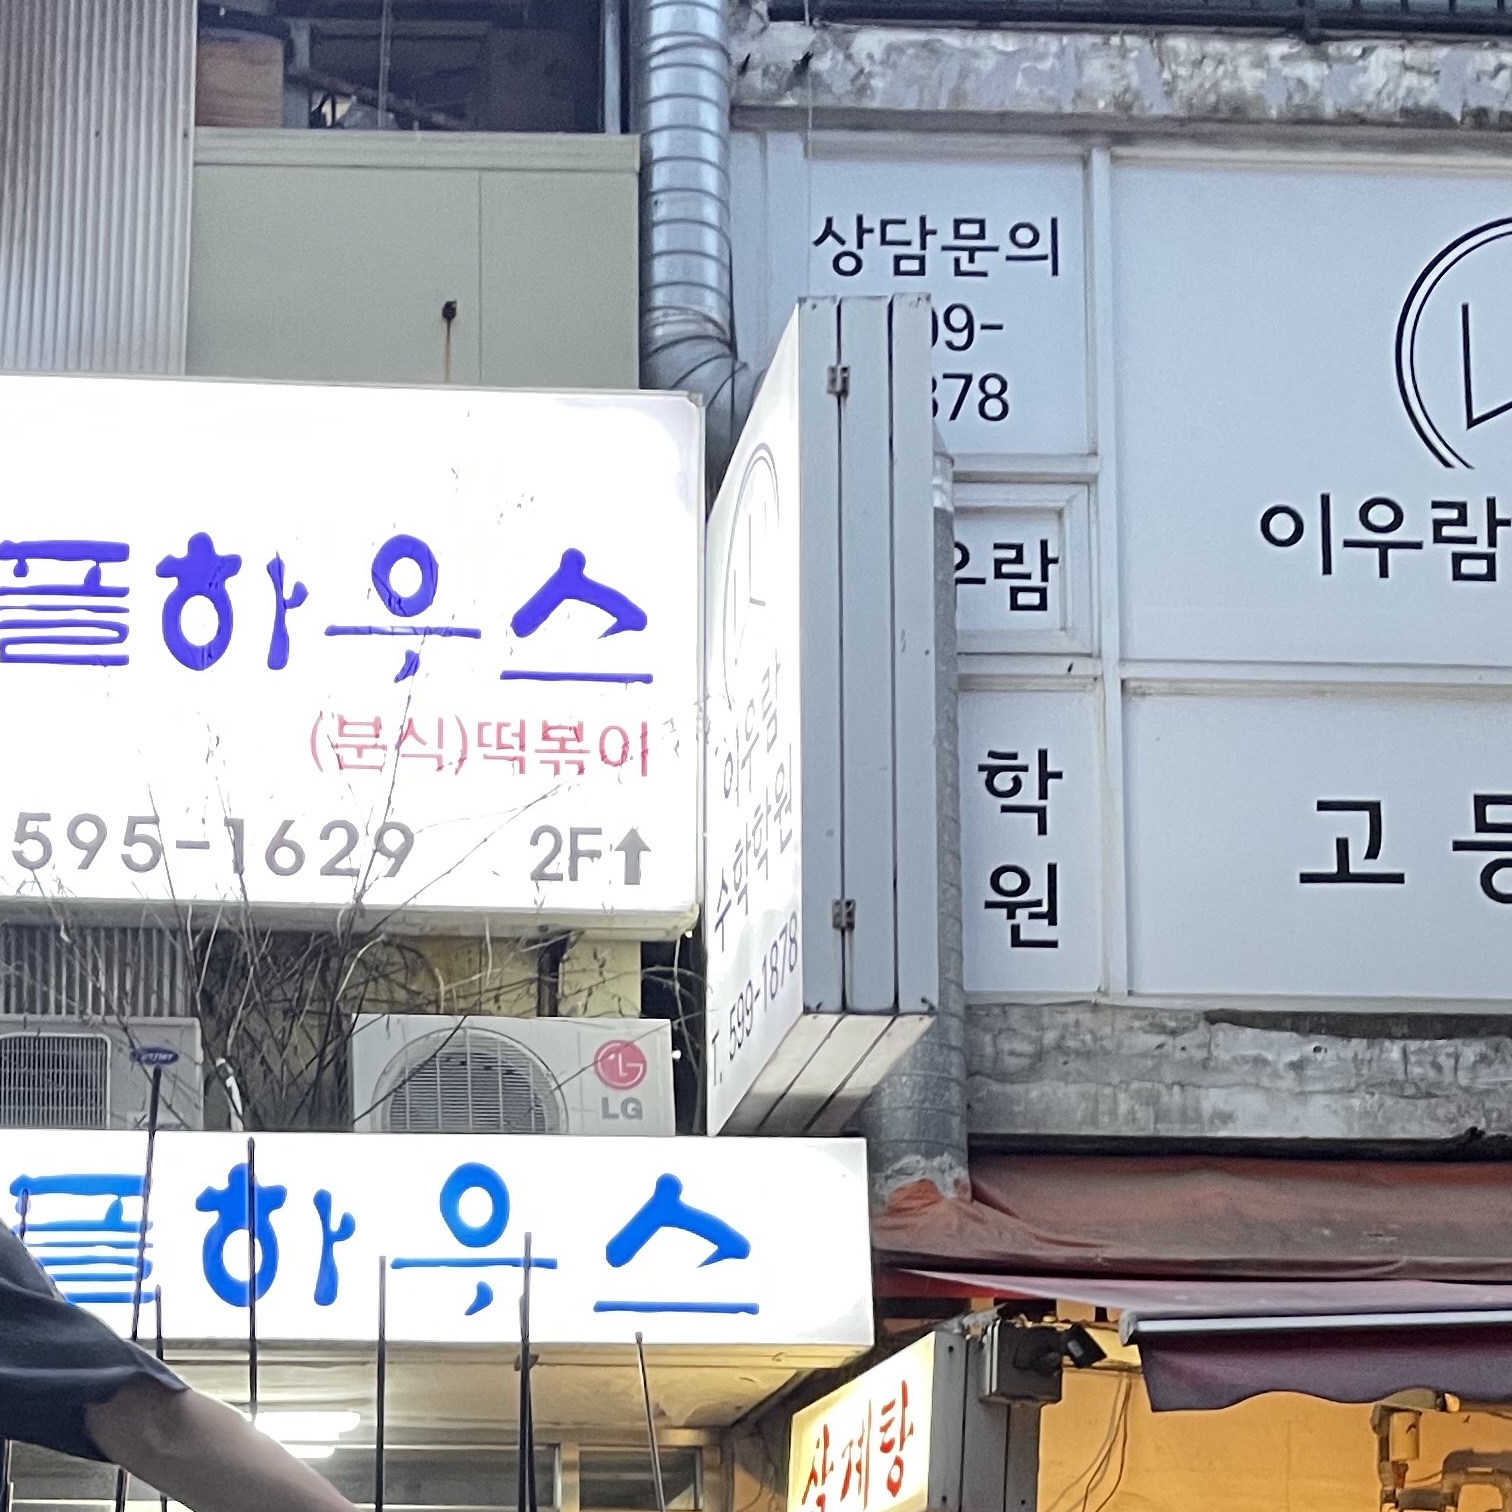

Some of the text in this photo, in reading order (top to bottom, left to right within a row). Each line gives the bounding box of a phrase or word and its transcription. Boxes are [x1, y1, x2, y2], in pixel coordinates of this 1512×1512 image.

[813, 214, 1059, 277] 상담문의
[931, 303, 1004, 352] 9-
[12, 811, 603, 882] 595-1629 2F
[714, 742, 793, 953] 수학학원
[728, 911, 799, 1062] 599-1878
[601, 1097, 644, 1120] LG
[9, 1160, 760, 1317] 플하우스
